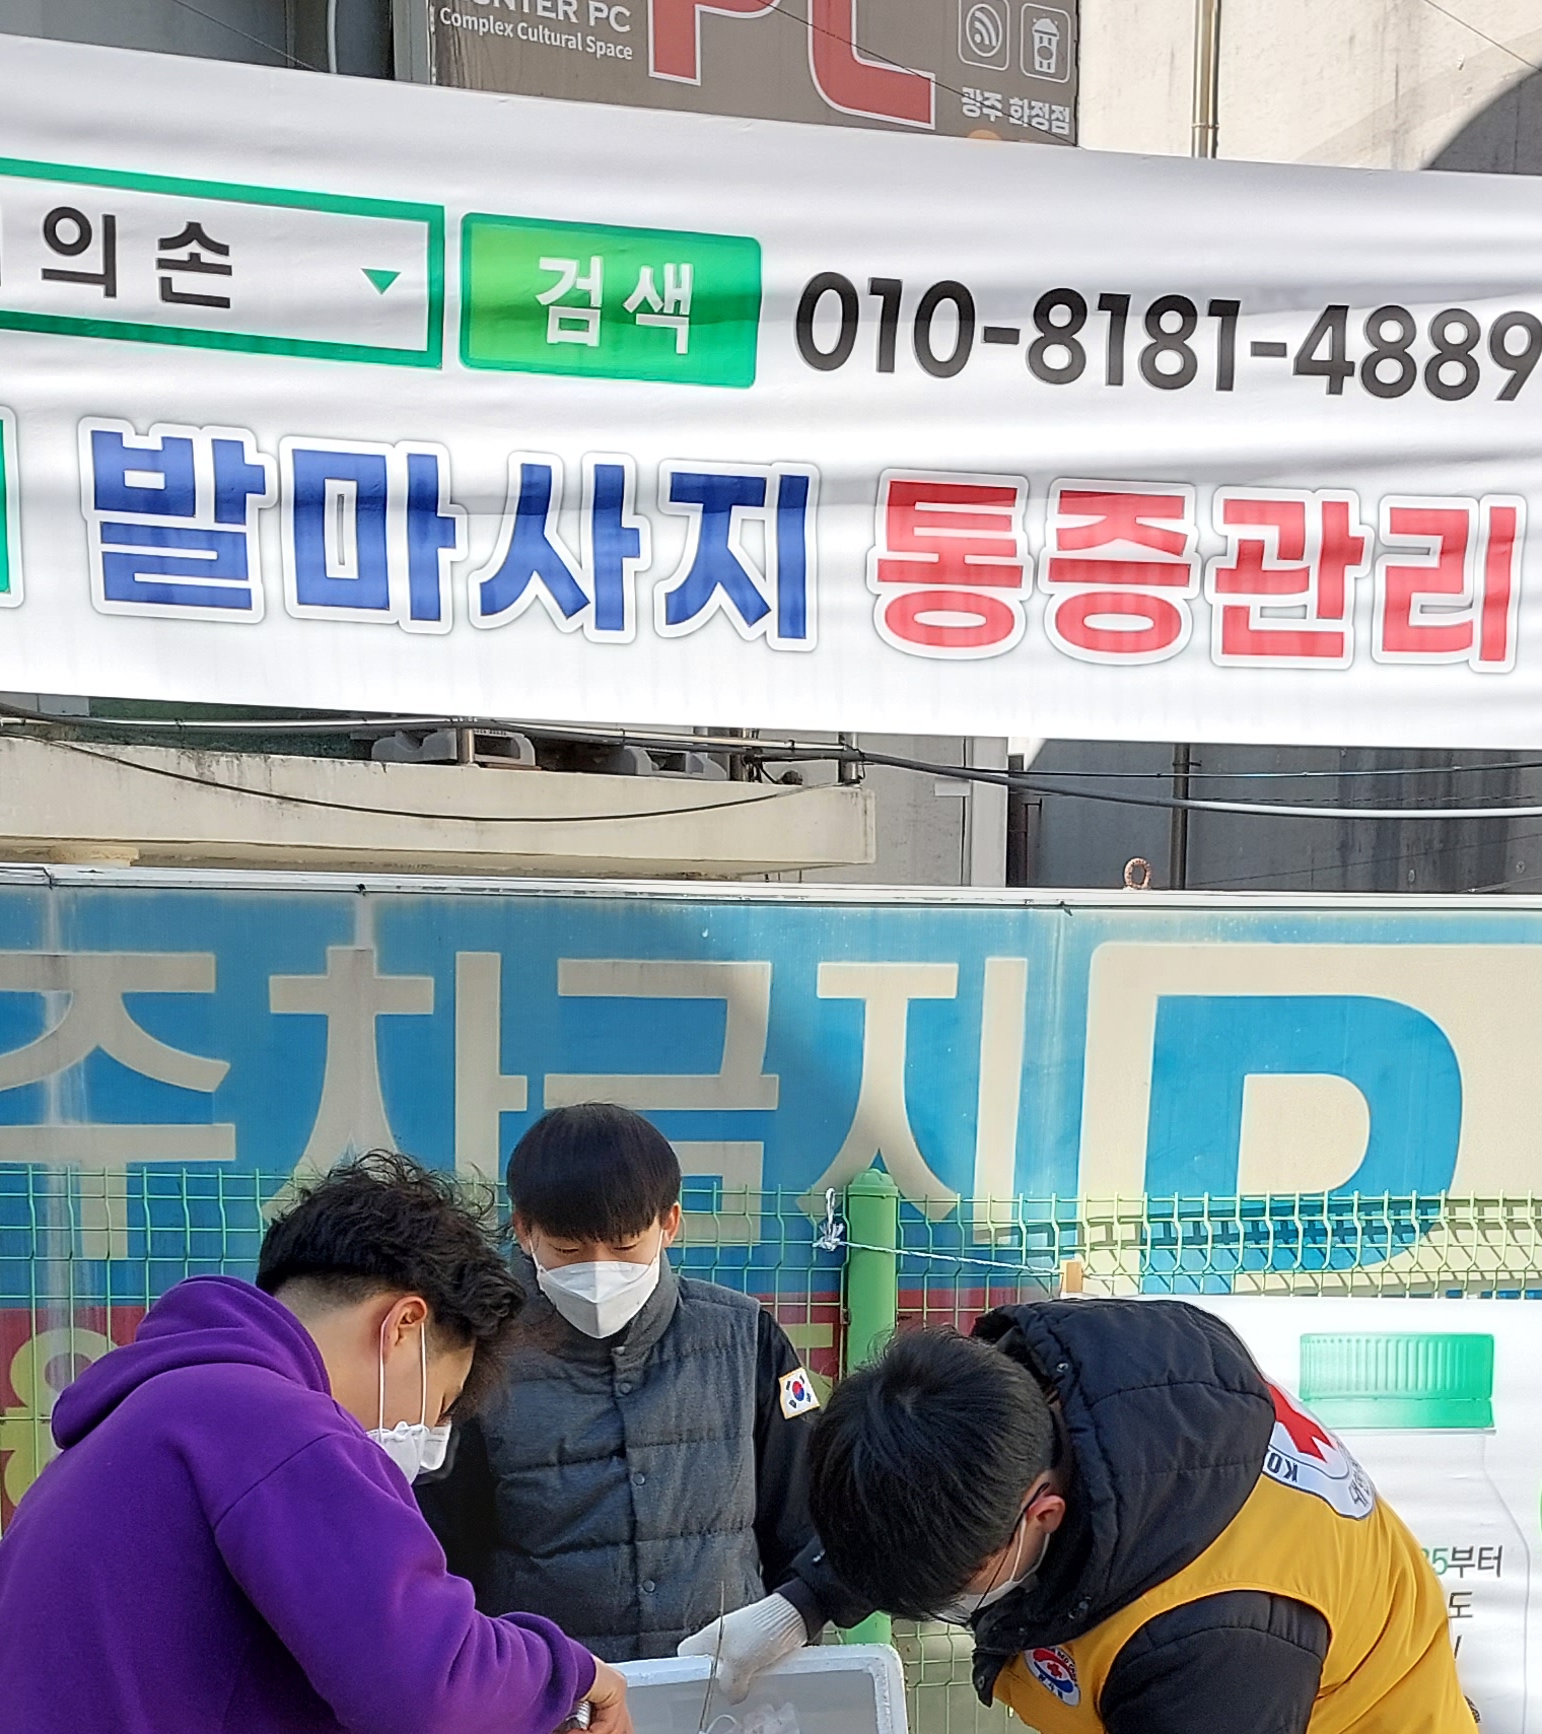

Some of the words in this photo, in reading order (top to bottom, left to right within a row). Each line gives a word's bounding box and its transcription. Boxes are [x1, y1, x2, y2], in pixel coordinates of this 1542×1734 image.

[439, 7, 514, 38] Complex
[516, 21, 583, 51] Cultural
[585, 35, 633, 61] Space
[588, 0, 632, 33] PC
[961, 86, 1003, 122] 광주
[1008, 96, 1071, 136] 화정점
[533, 254, 697, 356] 검색
[84, 425, 814, 643] 발마사지
[871, 476, 1521, 666] 통증관리
[1139, 994, 1464, 1294] P
[1422, 1544, 1504, 1579] 5부터
